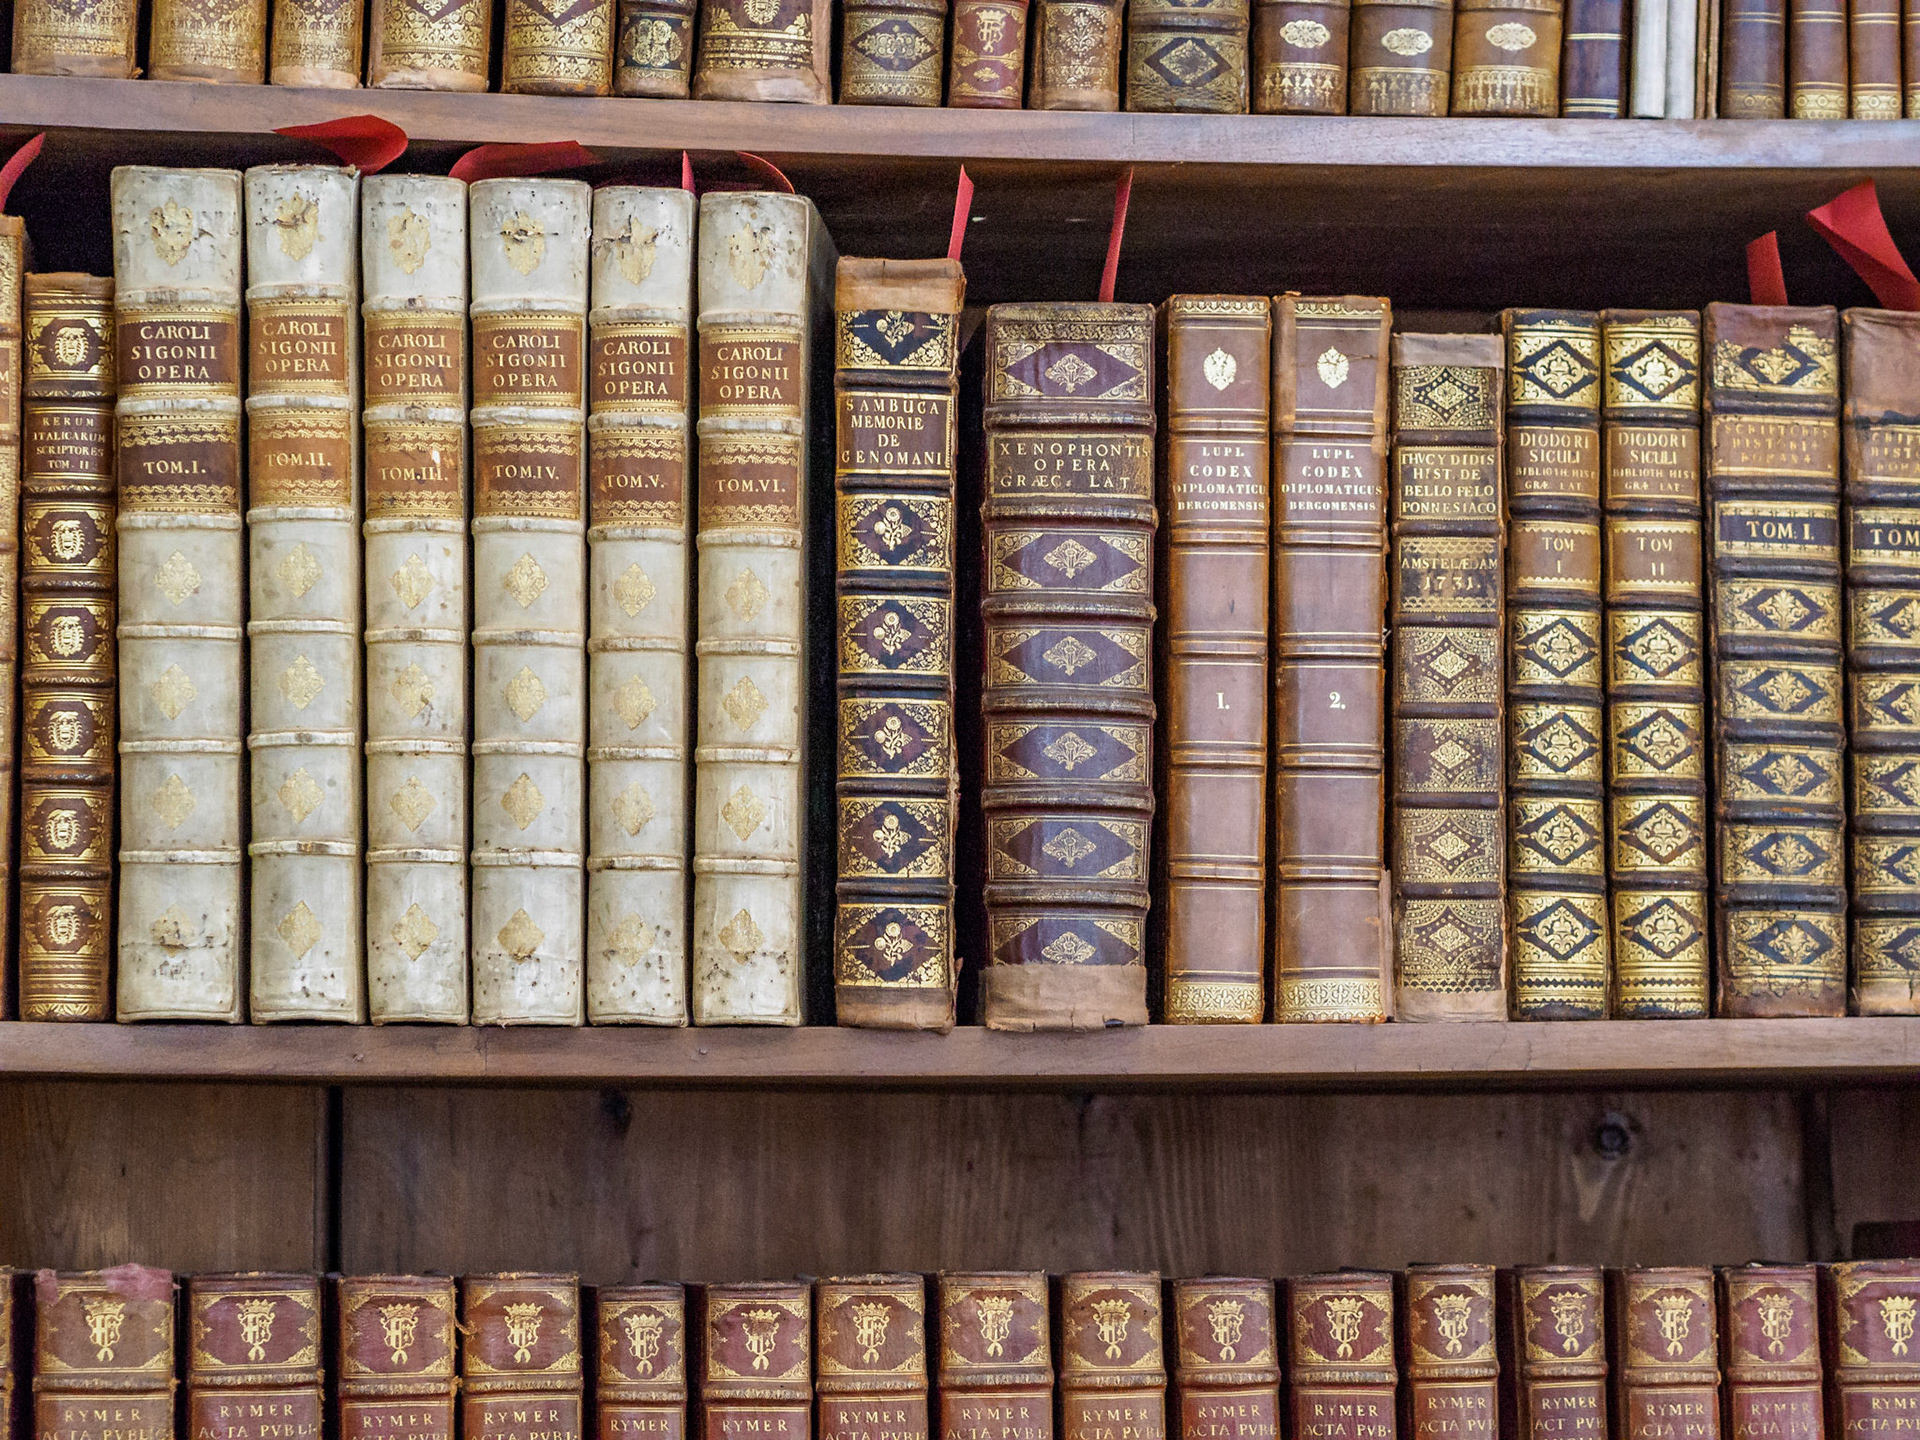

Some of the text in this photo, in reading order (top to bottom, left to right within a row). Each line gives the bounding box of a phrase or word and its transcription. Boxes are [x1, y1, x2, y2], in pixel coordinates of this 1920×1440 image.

[140, 325, 210, 340] CAROLI
[262, 322, 331, 336] CAROLI
[259, 341, 337, 355] SIGONII
[378, 334, 446, 349] CAROLI
[492, 334, 561, 349] CAROLI
[131, 346, 217, 360] SIGONII
[603, 342, 672, 356] CAROLI
[717, 347, 784, 361] CAROLI
[265, 359, 330, 372] OPERA
[374, 354, 453, 368] SIGONII
[485, 354, 567, 368] SIGONII
[138, 365, 210, 380] OPERA
[599, 361, 675, 376] SIGONII
[711, 365, 790, 381] SIGONII
[380, 373, 444, 387] OPERA
[493, 372, 558, 387] OPERA
[604, 380, 669, 395] OPERA
[719, 385, 782, 399] OPERA
[846, 400, 940, 415] SAMBUCA
[42, 416, 94, 427] RERUM
[851, 416, 924, 430] MEMORIE
[33, 431, 106, 443] ITALICARUM
[877, 433, 901, 447] DE
[1520, 432, 1589, 449] DIODORI
[1618, 432, 1687, 448] DIODORI
[36, 445, 104, 457] SCRIPTORES
[1000, 443, 1149, 458] XENOPHONTIS
[1529, 449, 1580, 464] SICULI
[1630, 450, 1677, 464] SICULI
[80, 460, 89, 470] II
[841, 450, 942, 466] CENOMANI
[1034, 459, 1111, 472] OPERA
[1190, 465, 1252, 477] CODEX
[1302, 466, 1363, 478] CODEX
[1460, 468, 1481, 480] DE
[1090, 475, 1132, 489] LAT
[1281, 483, 1383, 495] DIPLOMATICUS
[1404, 485, 1452, 497] BELLO
[1178, 501, 1265, 511] BERGOMENSIS
[1289, 502, 1376, 511] BERGOMENSIS
[1541, 537, 1575, 552] TOM
[1637, 537, 1673, 552] TOM
[1556, 560, 1561, 573] I
[1651, 562, 1665, 576] II
[1329, 691, 1346, 710] 2.
[1428, 1397, 1487, 1409] RYMER
[1542, 1396, 1597, 1410] RYMER
[1646, 1404, 1705, 1416] RYMER
[1751, 1403, 1811, 1415] RYMER
[65, 1408, 141, 1422] RYMER
[221, 1404, 293, 1417] RYMER
[484, 1409, 559, 1424] RYMER
[840, 1410, 907, 1424] RYMER
[963, 1406, 1030, 1420] RYMER
[1083, 1408, 1148, 1422] RYMER
[1198, 1405, 1260, 1418] RYMER
[1315, 1404, 1378, 1417] RYMER
[363, 1413, 433, 1428] RYMER
[610, 1419, 670, 1432] RYMER
[722, 1419, 788, 1432] RYMER
[1419, 1420, 1460, 1433] ACTA
[1535, 1418, 1565, 1431] ACT
[1847, 1418, 1891, 1430] ACTA
[199, 1426, 248, 1439] ACTA
[947, 1427, 992, 1440] ACTA
[1069, 1427, 1114, 1440] ACTA
[1187, 1424, 1230, 1437] ACTA
[1304, 1423, 1346, 1436] ACTA
[1633, 1423, 1675, 1437] ACTA
[1738, 1421, 1781, 1435] ACTA
